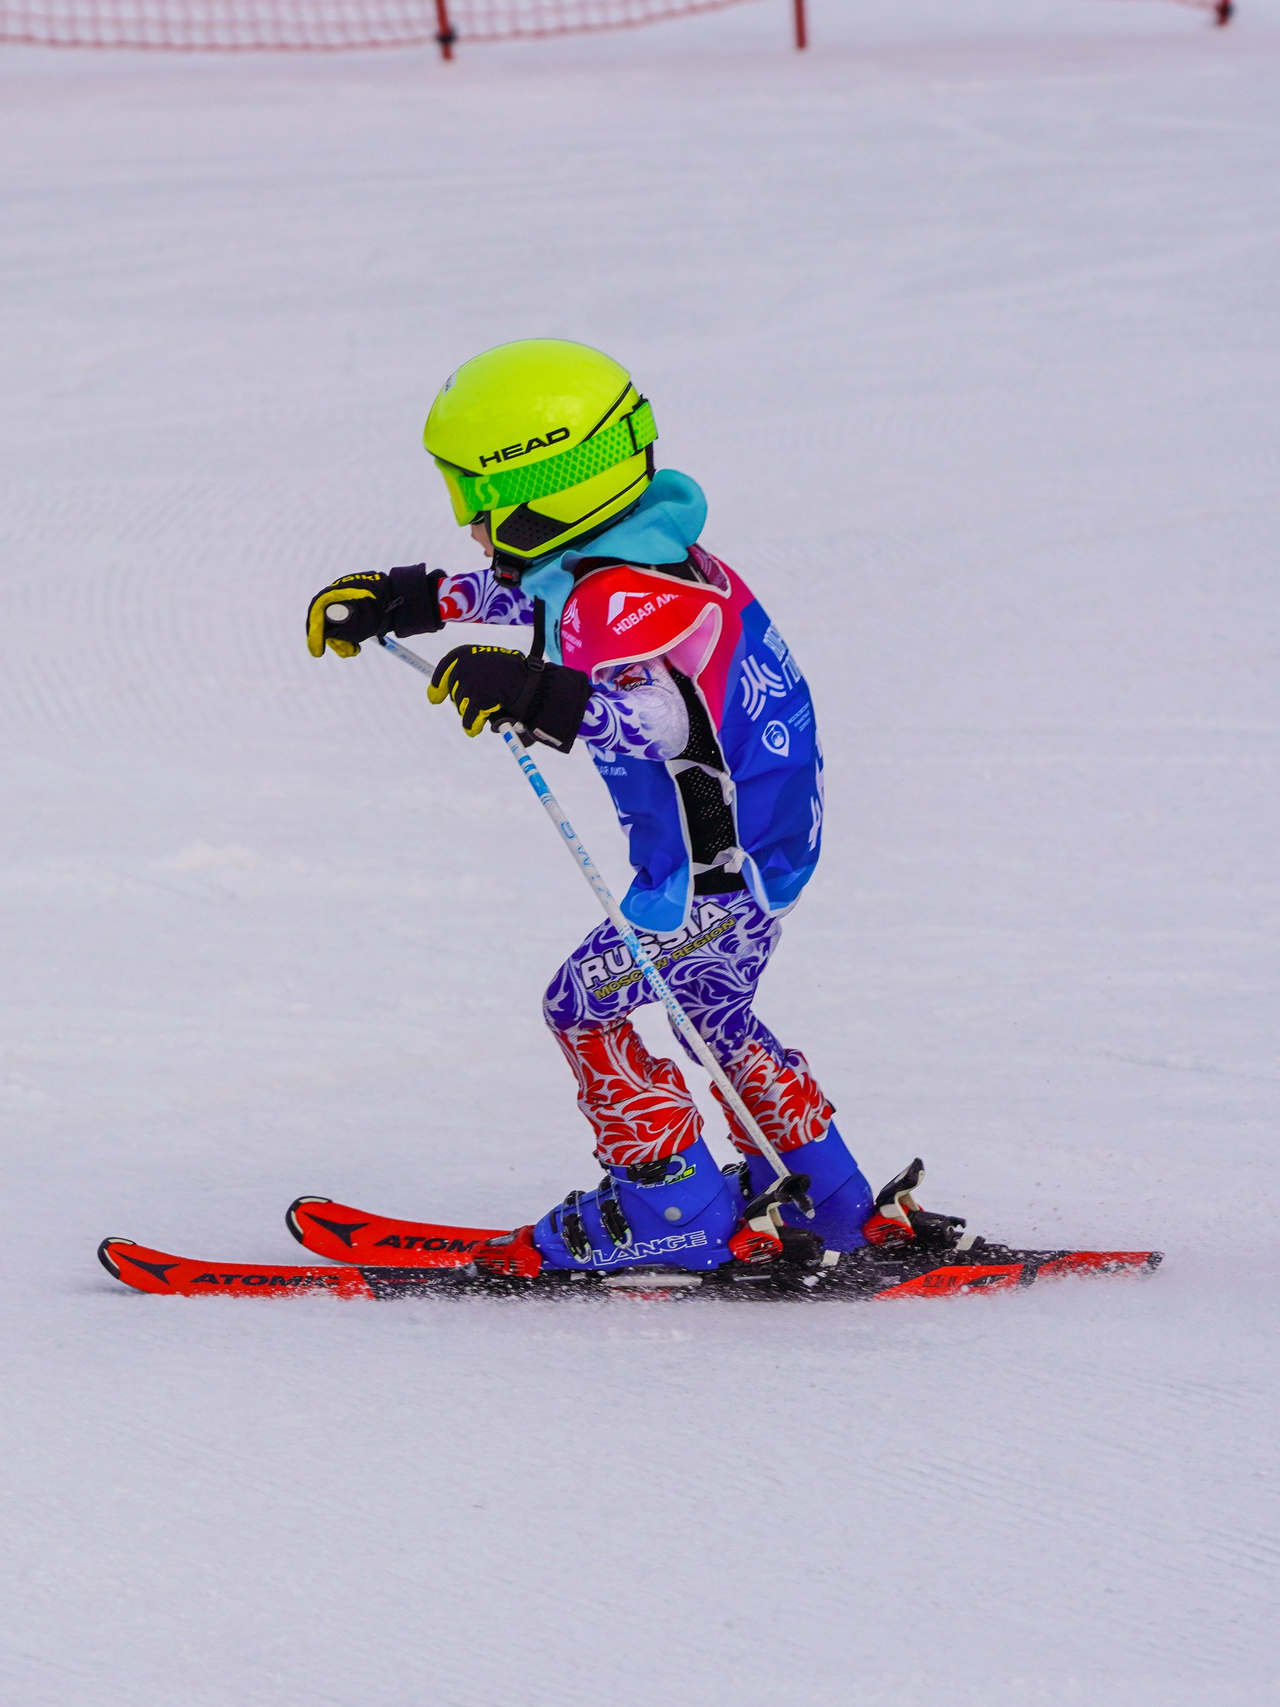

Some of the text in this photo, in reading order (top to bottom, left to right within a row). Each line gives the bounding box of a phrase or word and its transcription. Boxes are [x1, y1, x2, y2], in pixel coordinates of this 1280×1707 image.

[479, 427, 570, 468] HEAD
[612, 593, 680, 635] НОВАЯ ЛИ
[593, 917, 737, 1000] MOSCW REGION
[373, 1234, 480, 1253] ATOM
[592, 1230, 708, 1266] LANGE
[190, 1273, 343, 1287] ATOMIC
